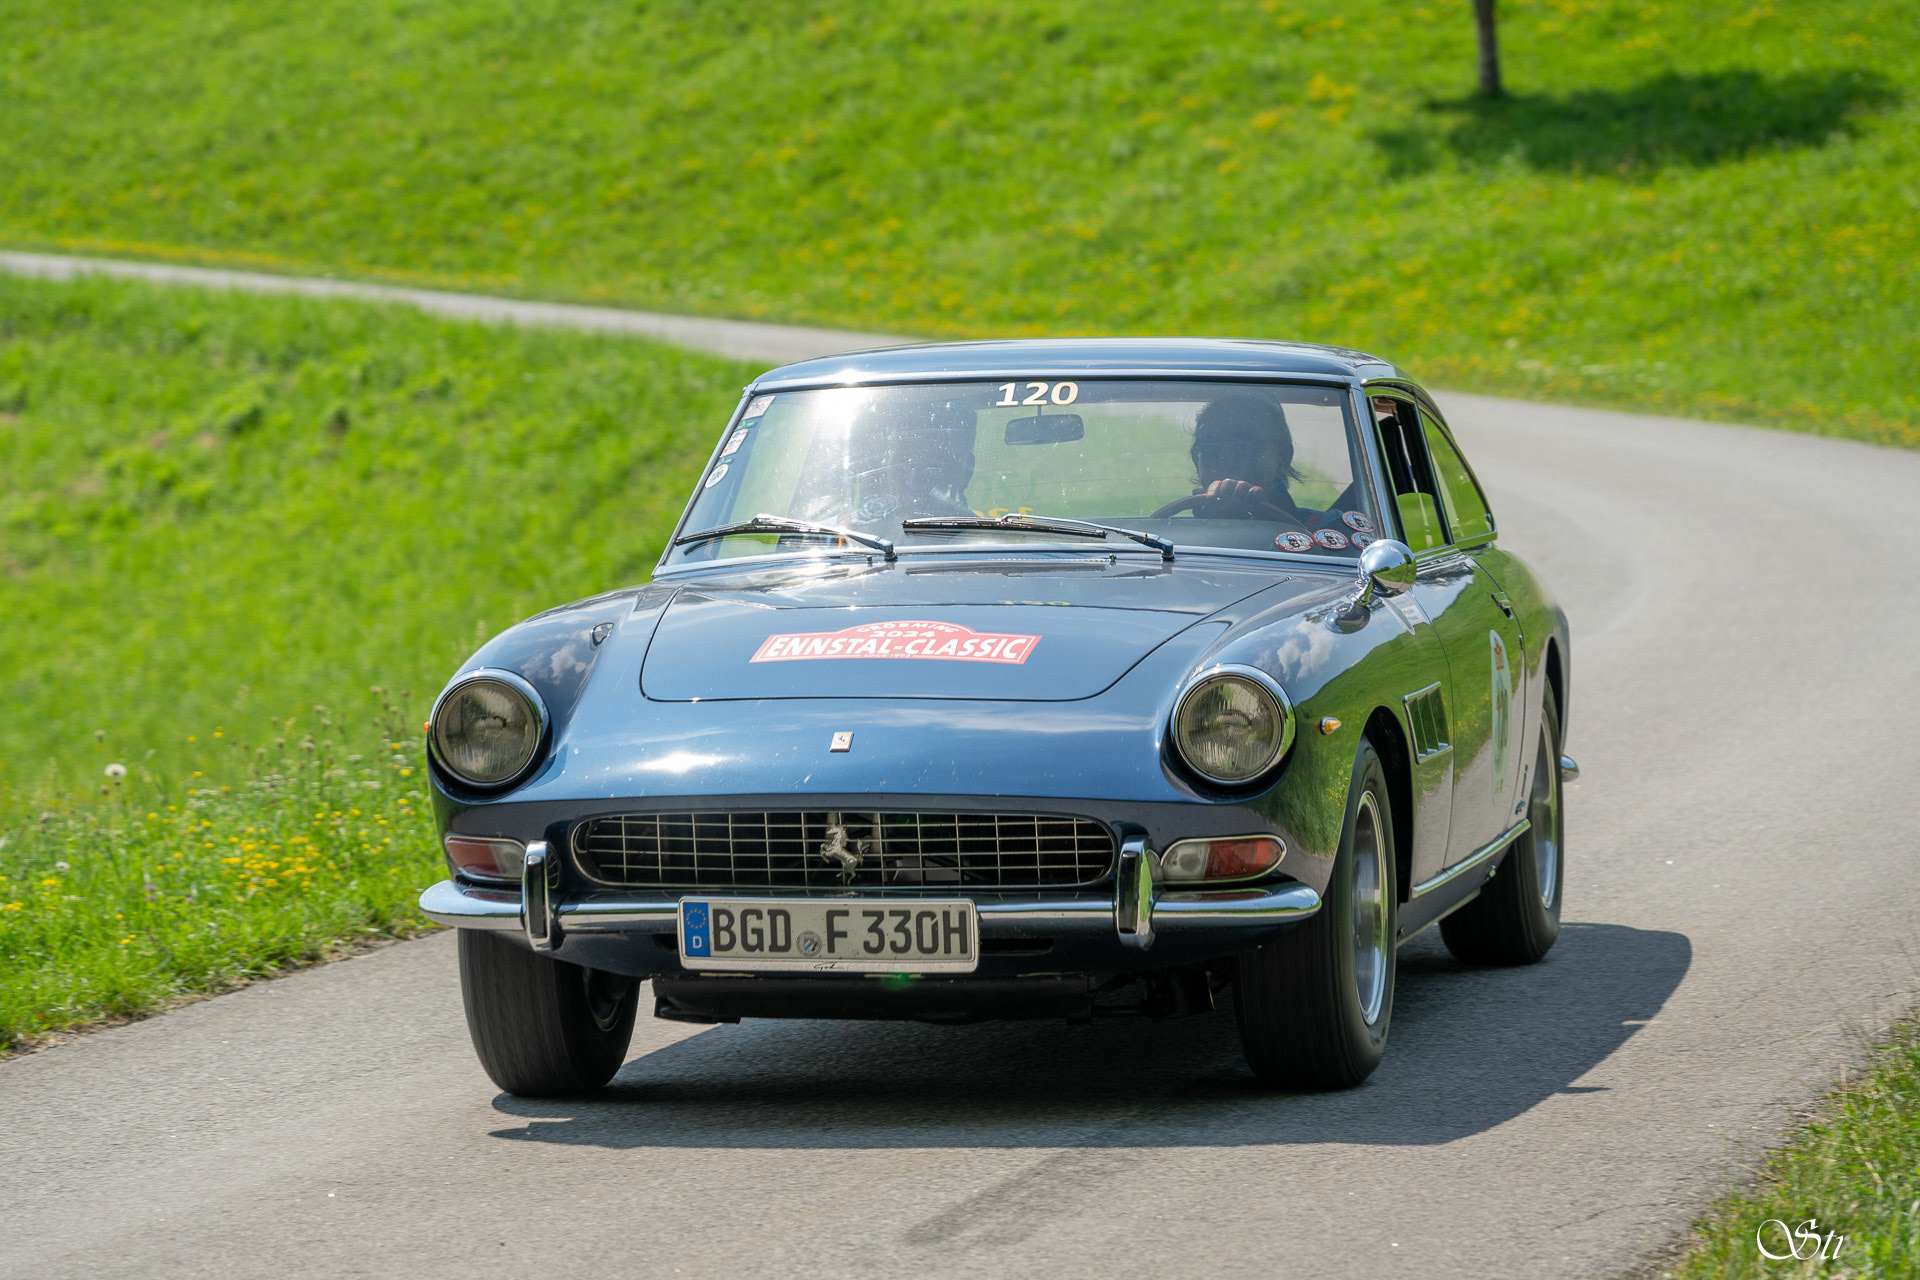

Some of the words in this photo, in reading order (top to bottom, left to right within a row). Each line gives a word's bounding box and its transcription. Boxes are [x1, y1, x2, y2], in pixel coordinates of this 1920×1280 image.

[996, 382, 1078, 407] 120
[870, 630, 936, 638] 2024
[764, 637, 1028, 659] ENNSTAL-CLASSIC
[692, 935, 703, 949] D
[712, 908, 792, 953] BGD
[826, 910, 850, 954] F
[862, 910, 968, 954] 330H
